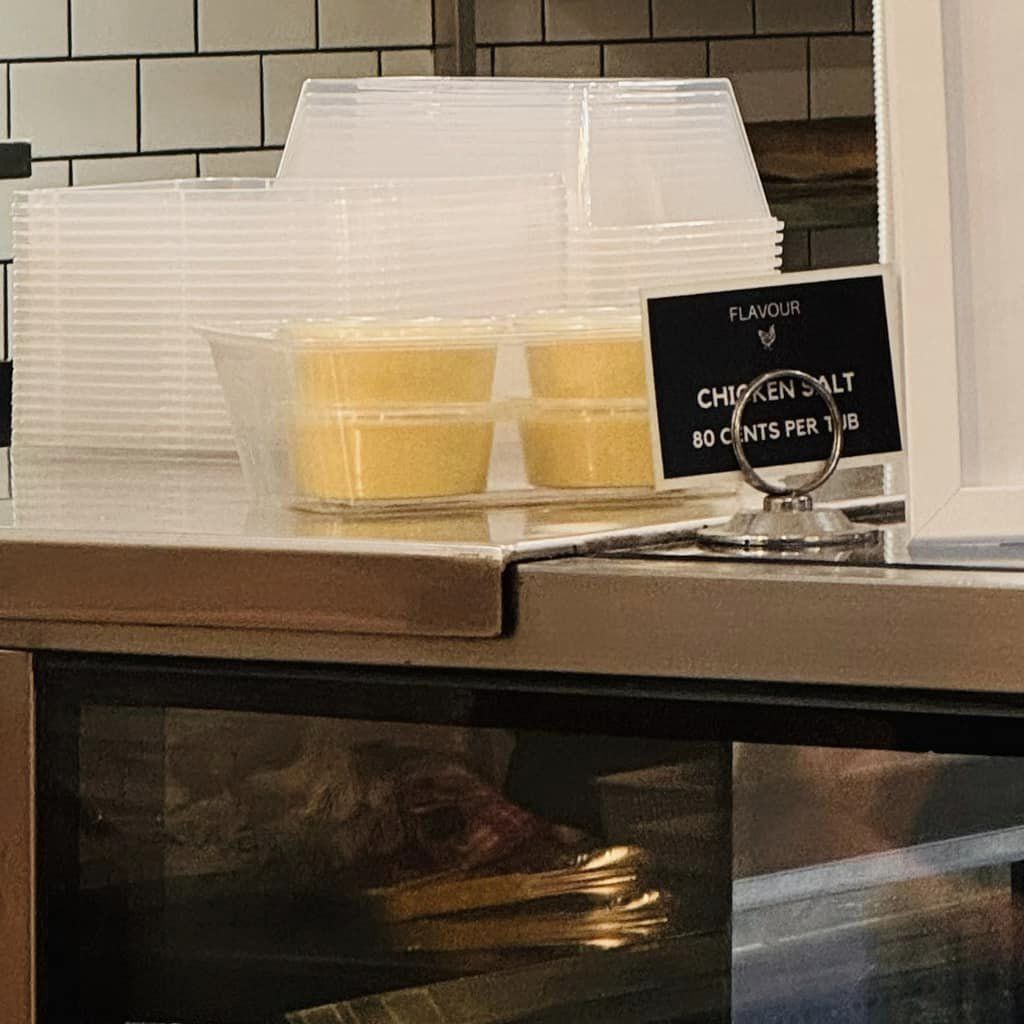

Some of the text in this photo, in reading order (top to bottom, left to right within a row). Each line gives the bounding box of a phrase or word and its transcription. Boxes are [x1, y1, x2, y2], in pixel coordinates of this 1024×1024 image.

[729, 300, 800, 322] FLAVOUR
[801, 372, 855, 397] SALT
[692, 429, 715, 448] 80
[720, 422, 781, 445] CNTS
[785, 417, 819, 437] PER
